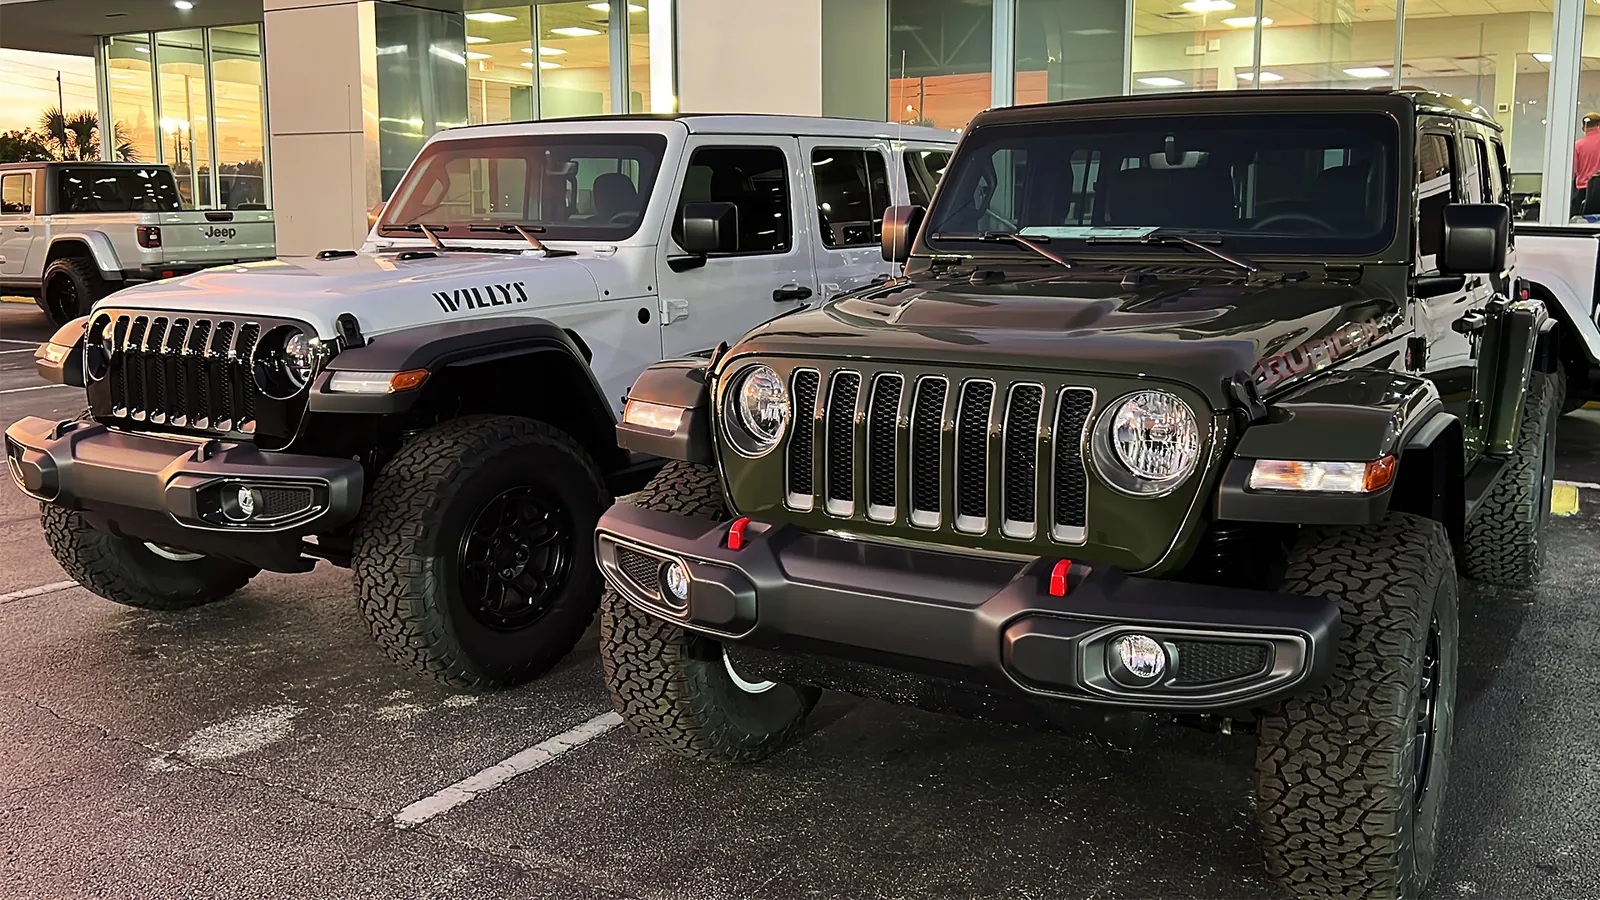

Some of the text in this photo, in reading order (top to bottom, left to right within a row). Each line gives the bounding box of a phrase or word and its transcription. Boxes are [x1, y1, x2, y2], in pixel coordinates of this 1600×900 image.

[205, 226, 236, 239] Jeep
[432, 282, 528, 312] WILLYS
[1257, 317, 1379, 385] RUBICON
